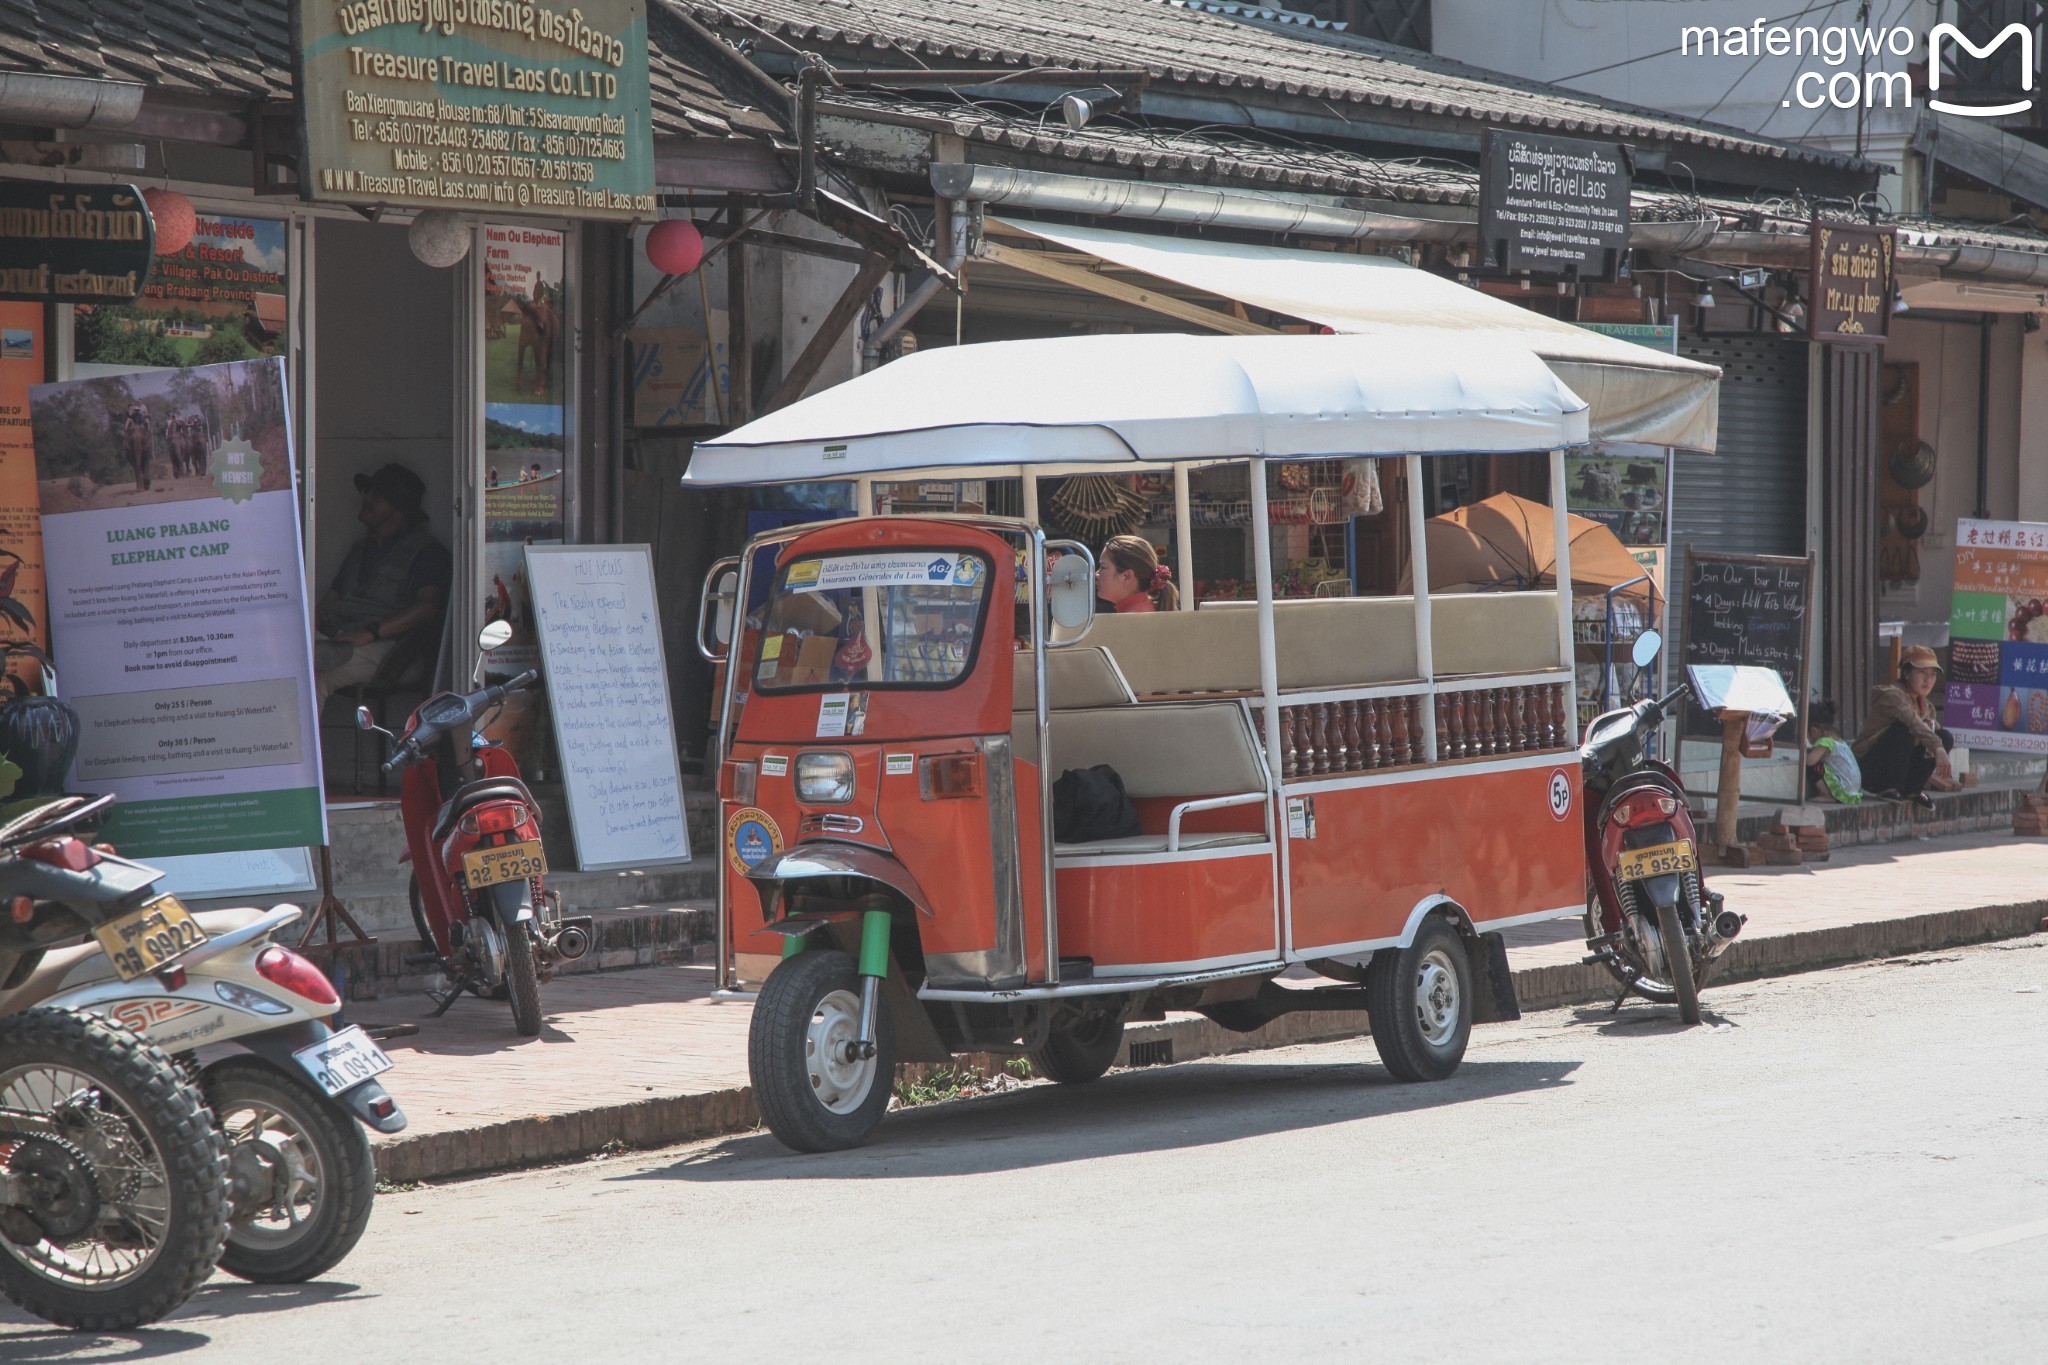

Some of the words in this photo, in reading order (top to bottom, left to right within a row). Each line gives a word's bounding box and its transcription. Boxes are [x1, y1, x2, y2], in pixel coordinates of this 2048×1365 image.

[350, 47, 438, 81] Treasure
[442, 56, 498, 88] Travel
[504, 62, 546, 92] Laos
[603, 113, 625, 135] Road
[1508, 167, 1541, 192] Jewel
[1543, 171, 1578, 197] Travel
[1581, 175, 1606, 199] Laos
[518, 183, 530, 206] @
[1505, 196, 1532, 208] Adventure
[1533, 199, 1548, 210] Travel
[1564, 203, 1590, 216] Community
[1591, 205, 1601, 215] Trek
[1608, 208, 1618, 217] Laos
[486, 228, 506, 242] Nam
[508, 230, 521, 243] Ou
[522, 232, 561, 247] Elephant
[185, 243, 195, 260] &
[199, 243, 244, 263] Resort
[486, 246, 509, 260] Farm
[162, 263, 201, 280] Village,
[204, 265, 222, 280] Pak
[226, 268, 240, 281] Ou
[242, 270, 280, 285] District
[166, 283, 210, 301] Prabang
[213, 286, 257, 302] Province
[1601, 325, 1639, 336] TRAVEL
[227, 452, 245, 465] HOT
[221, 471, 253, 485] NEWS!!
[106, 526, 156, 543] LUANG
[160, 519, 230, 538] PRABANG
[111, 546, 186, 566] ELEPHANT
[189, 542, 230, 559] CAMP
[1956, 548, 1975, 565] DIY
[596, 558, 625, 577] NEWS
[1692, 561, 1718, 586] Join
[1723, 565, 1743, 584] Our
[1744, 566, 1770, 587] Tour
[1778, 568, 1800, 589] Here
[821, 575, 856, 584] Assurances
[859, 573, 892, 582] Générales
[894, 571, 903, 580] du
[906, 571, 923, 579] Laos
[1704, 593, 1712, 608] 4
[123, 641, 138, 650] Daily
[139, 638, 172, 649] departures
[206, 632, 235, 642] 10.30am
[1700, 643, 1708, 654] 3
[153, 650, 168, 659] 1pm
[168, 649, 183, 657] from
[184, 647, 194, 656] our
[124, 664, 141, 673] Book
[142, 663, 155, 671] now
[156, 662, 163, 670] to
[164, 661, 182, 669] avoid
[155, 701, 170, 711] Only
[190, 698, 213, 708] Person
[158, 739, 174, 748] Only
[174, 738, 183, 747] 30
[193, 736, 216, 745] Person
[500, 857, 542, 878] 5239
[1651, 855, 1691, 872] 9525
[146, 920, 203, 962] 9922
[343, 1049, 388, 1079] 0911
